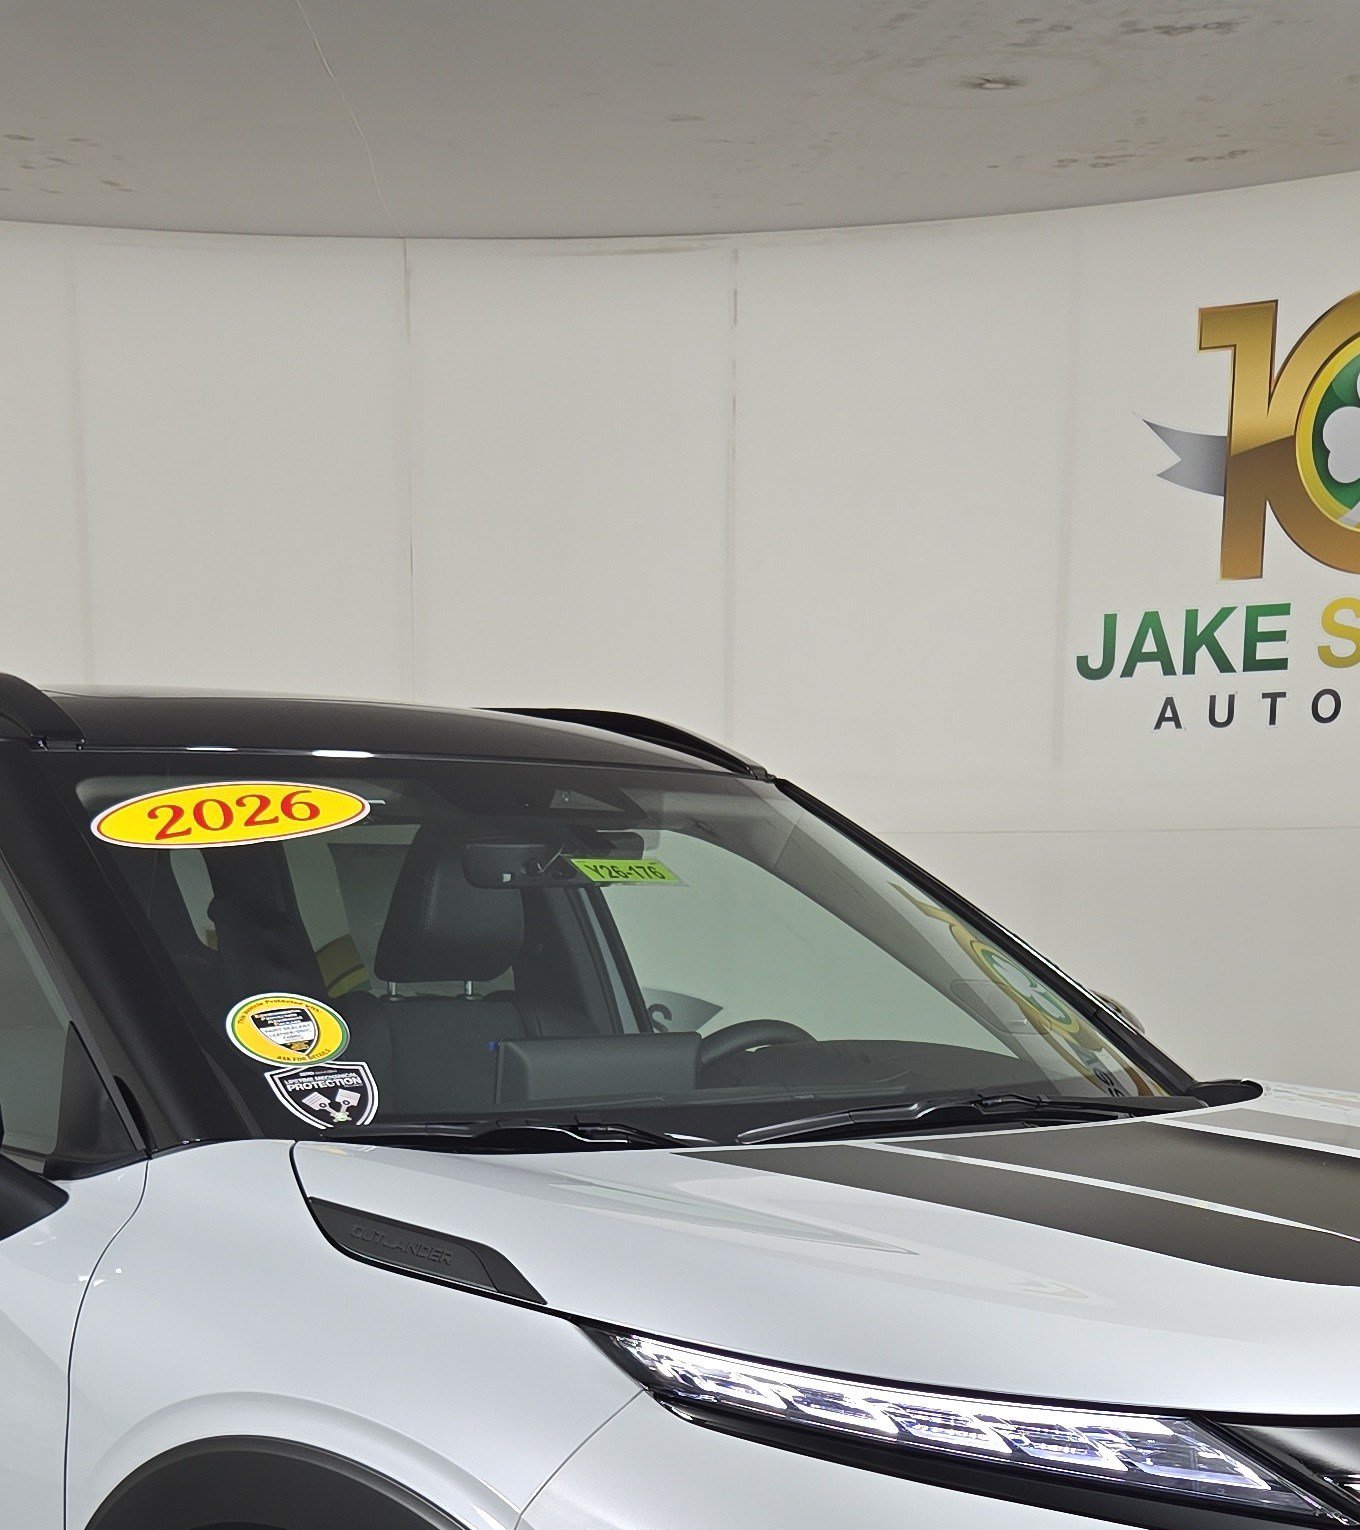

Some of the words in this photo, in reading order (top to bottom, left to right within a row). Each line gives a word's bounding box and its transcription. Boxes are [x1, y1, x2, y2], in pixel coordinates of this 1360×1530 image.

[1076, 602, 1292, 681] JAKE
[147, 790, 320, 840] 2026
[584, 864, 666, 880] Y26-176
[286, 1076, 363, 1092] PROTECTION
